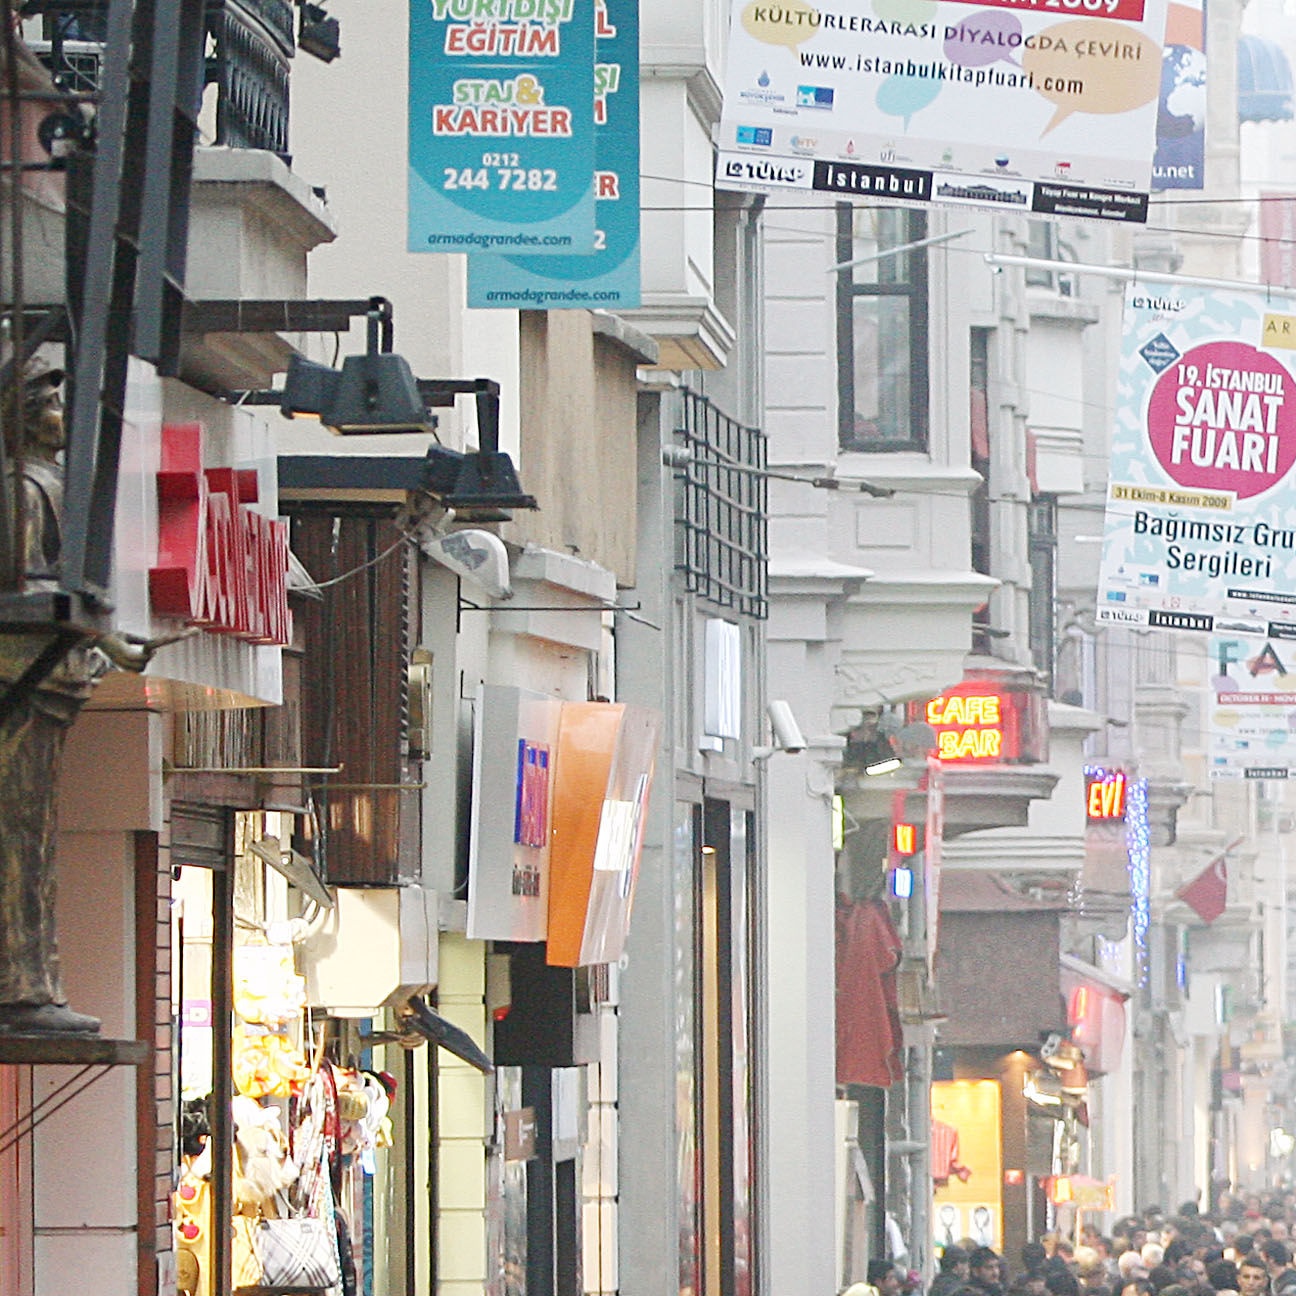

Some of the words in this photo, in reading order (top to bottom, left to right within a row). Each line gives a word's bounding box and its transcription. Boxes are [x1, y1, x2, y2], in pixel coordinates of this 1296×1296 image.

[447, 23, 557, 53] EĞİTİM
[754, 5, 936, 39] KÜLTÜRLERARASI
[945, 24, 1067, 53] DİYALOGDA
[1075, 41, 1142, 61] ÇEVİRİ
[800, 53, 1083, 95] www.istanbulkitapfuari.com
[482, 153, 519, 167] 0212
[444, 168, 489, 190] 244
[497, 168, 557, 190] 7282
[827, 165, 924, 195] İstanbul
[428, 232, 572, 249] armadagrandee.com
[486, 287, 620, 304] armadagrandee.com
[1177, 364, 1202, 386] 19.
[1206, 363, 1285, 396] İSTANBUL
[1175, 386, 1284, 434] SANAT
[1171, 424, 1280, 474] FUARI
[1202, 495, 1228, 508] 2009
[1134, 511, 1245, 544] Bağımsız
[1167, 546, 1272, 578] Sergileri
[926, 695, 1000, 725] CAFE
[938, 728, 1002, 759] BAR
